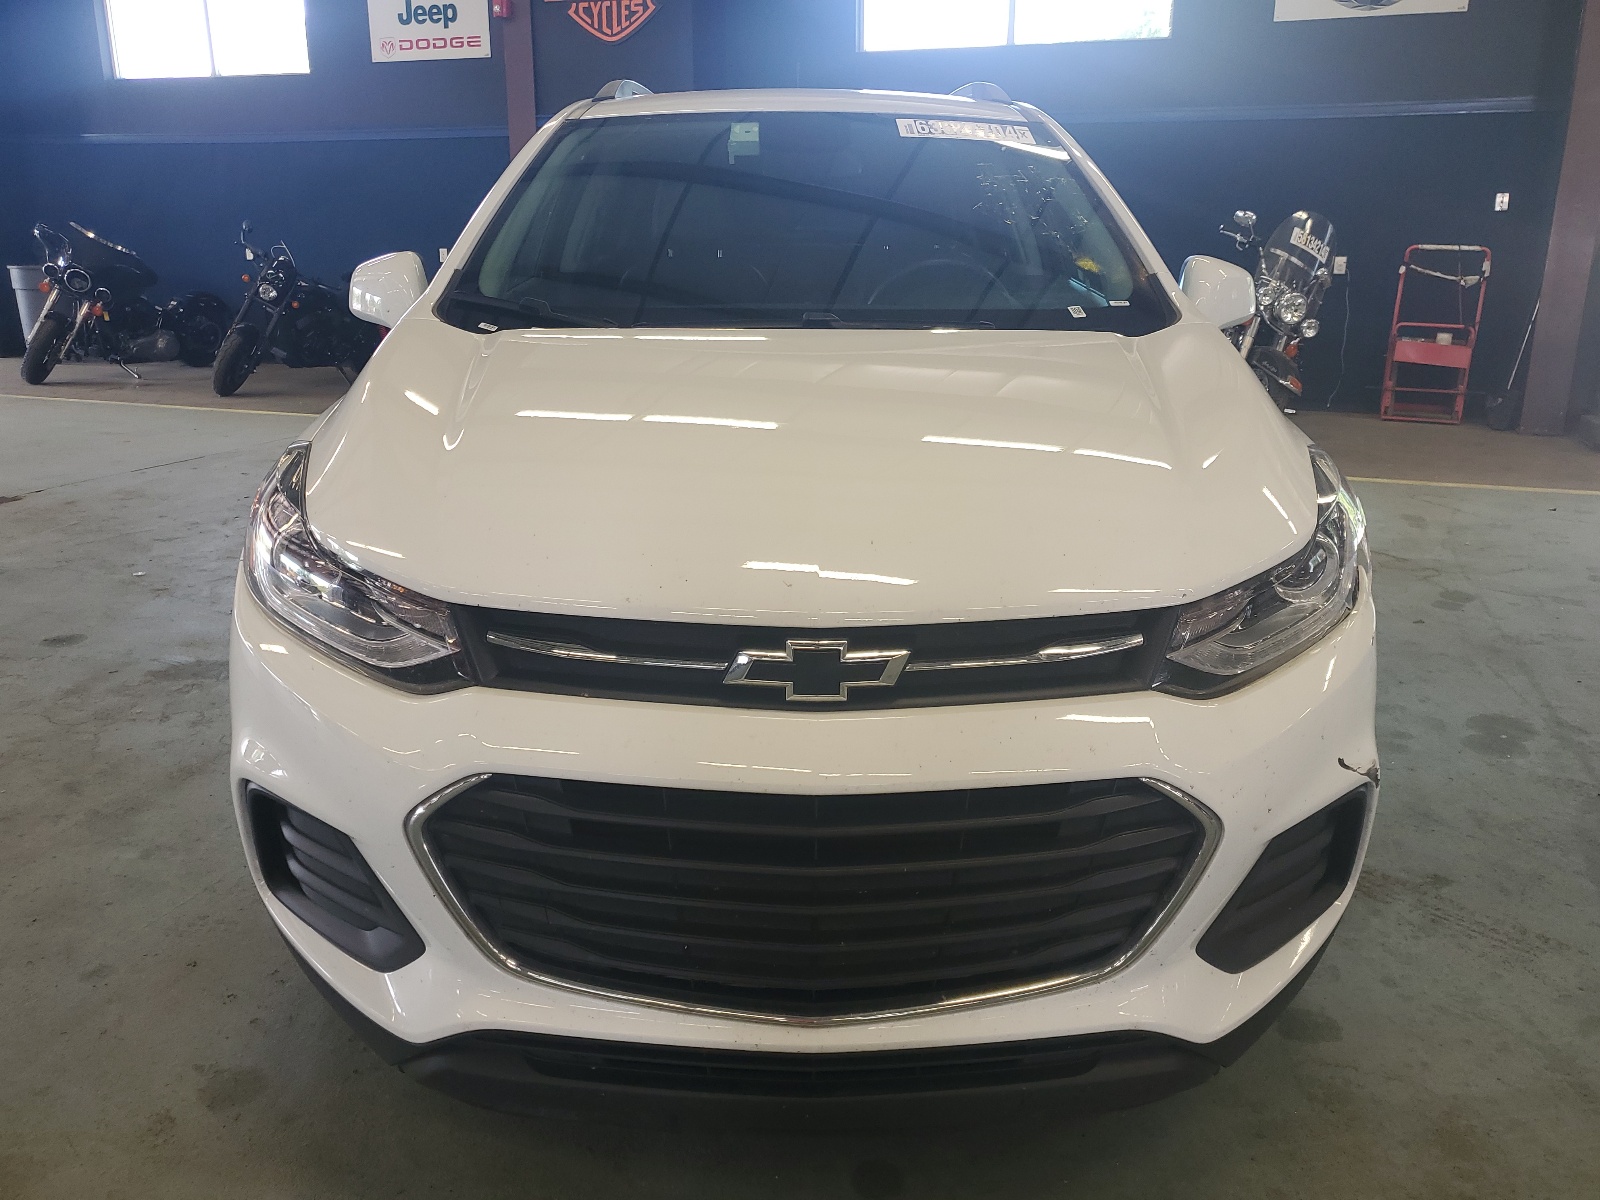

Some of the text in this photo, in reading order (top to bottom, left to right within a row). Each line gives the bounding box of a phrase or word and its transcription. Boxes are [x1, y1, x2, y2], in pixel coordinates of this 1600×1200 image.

[397, 0, 457, 29] Jeep
[578, 0, 644, 35] CYCLES
[399, 36, 481, 51] DODGE
